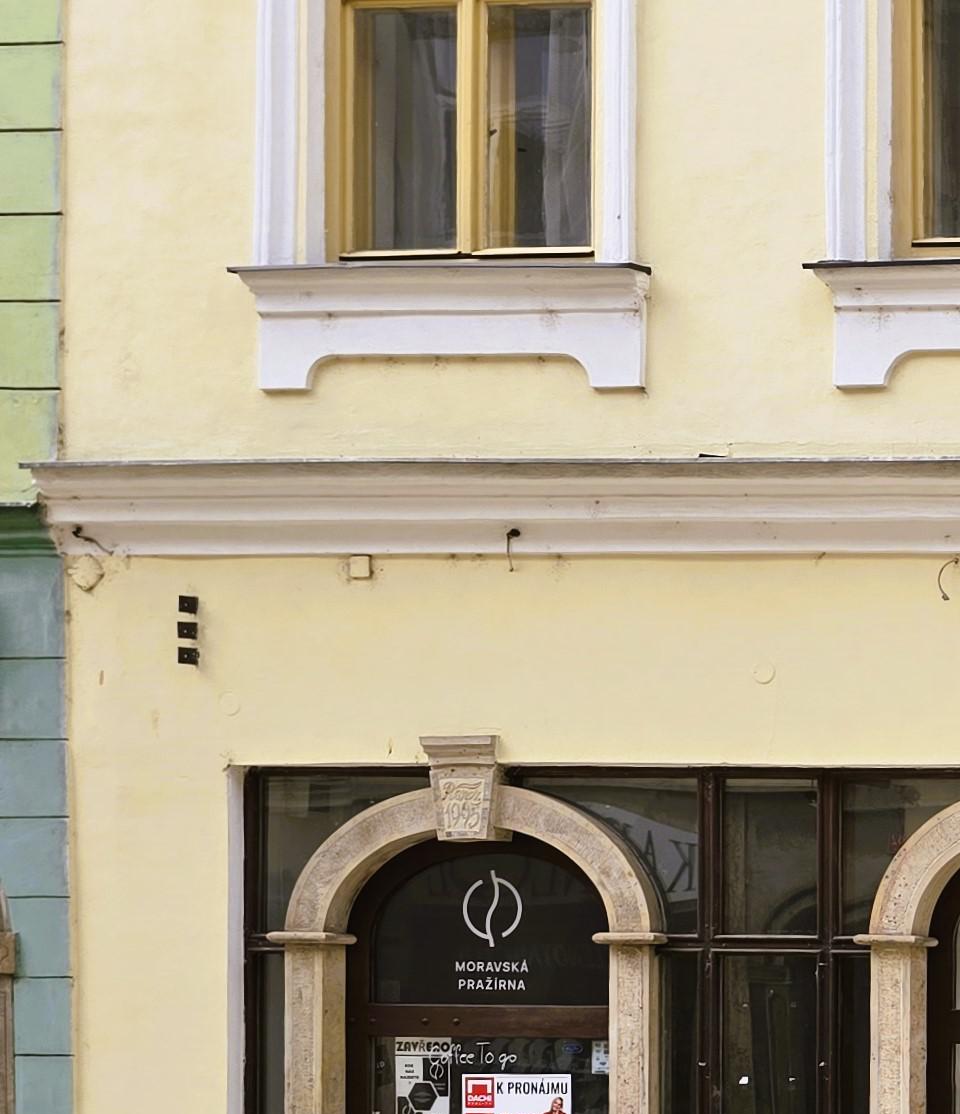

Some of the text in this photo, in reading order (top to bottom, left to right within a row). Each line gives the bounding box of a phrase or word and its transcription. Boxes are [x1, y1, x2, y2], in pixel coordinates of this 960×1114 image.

[455, 960, 529, 973] MORAVSKÁ
[458, 977, 526, 991] PRAŽÍRNA
[476, 1042, 495, 1064] To
[498, 1054, 517, 1070] go
[496, 1078, 568, 1095] K PRONÁJMU
